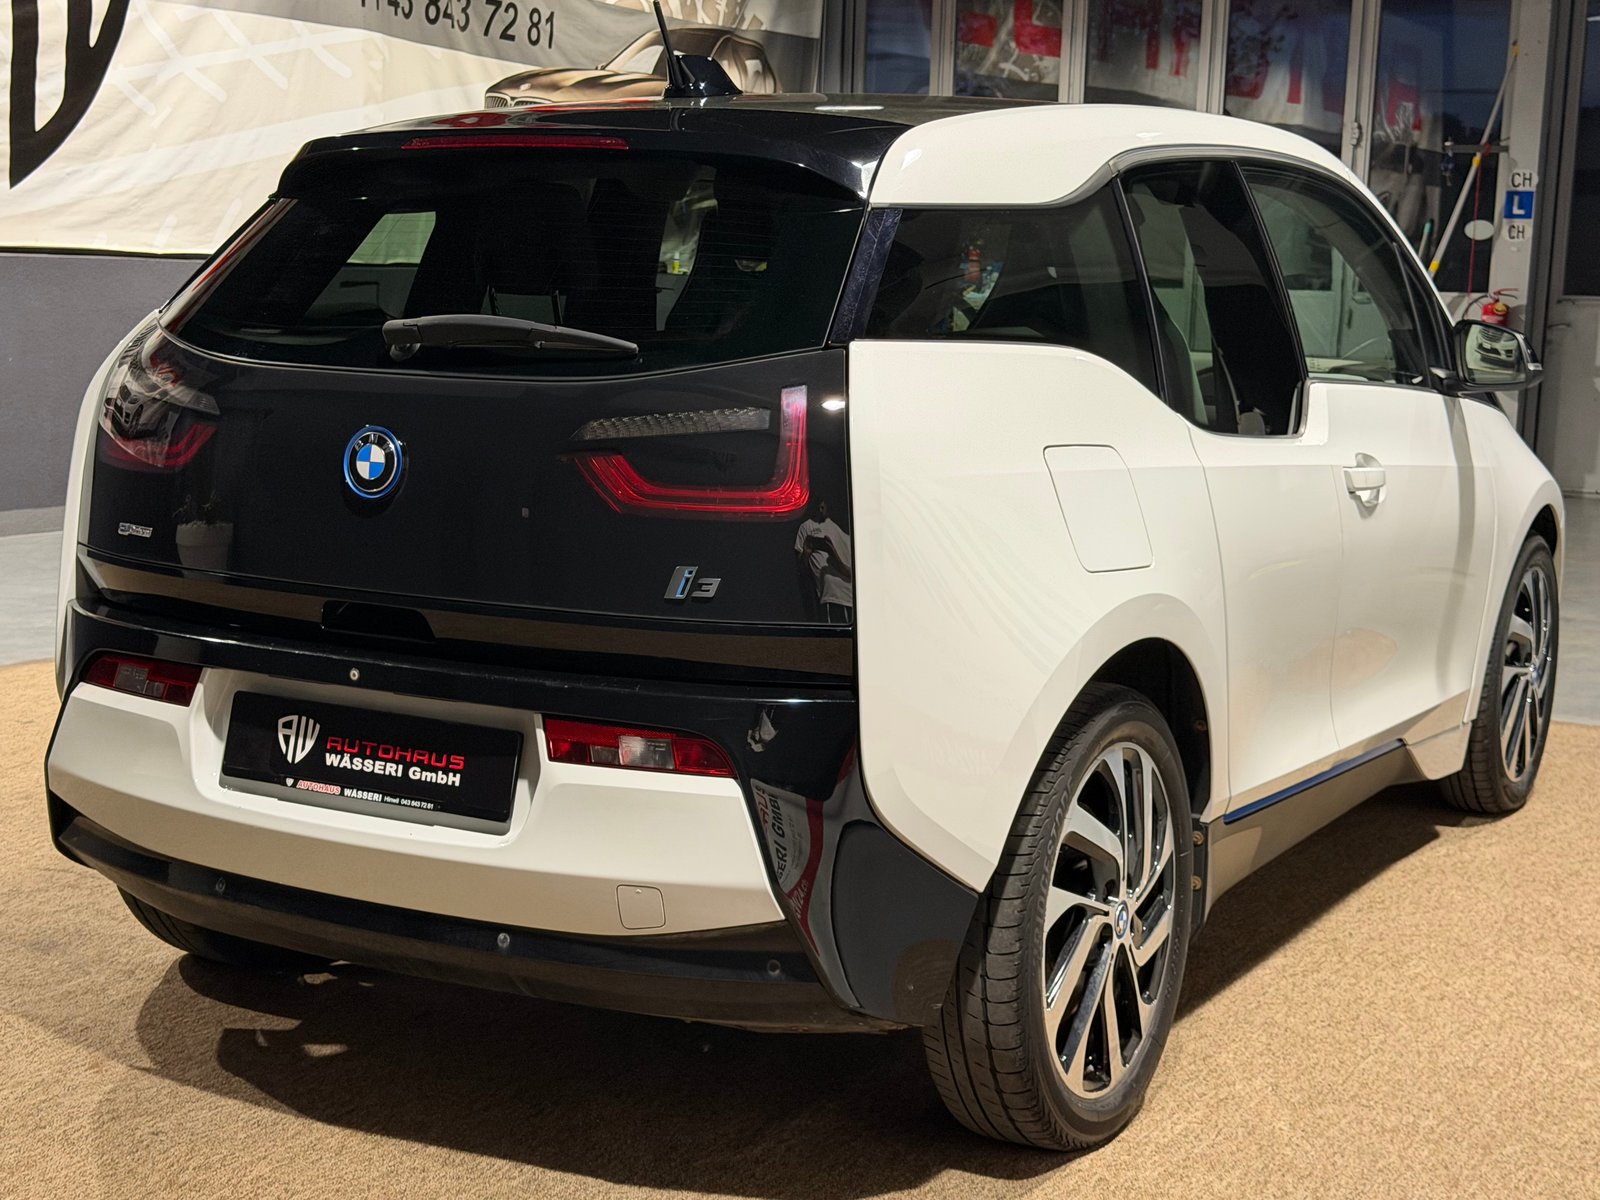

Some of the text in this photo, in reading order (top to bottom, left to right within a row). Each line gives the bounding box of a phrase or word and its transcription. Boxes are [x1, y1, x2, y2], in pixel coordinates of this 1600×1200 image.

[483, 0, 518, 41] 72
[527, 7, 554, 49] 81
[1511, 172, 1532, 188] CH
[1512, 194, 1526, 215] L
[1508, 224, 1525, 240] CH
[664, 565, 721, 600] i3
[326, 737, 465, 770] AUTOHAUS
[325, 752, 461, 787] WÄSSERI GmbH
[296, 780, 341, 795] AUTOHAUS
[344, 788, 382, 802] WÄSSERI
